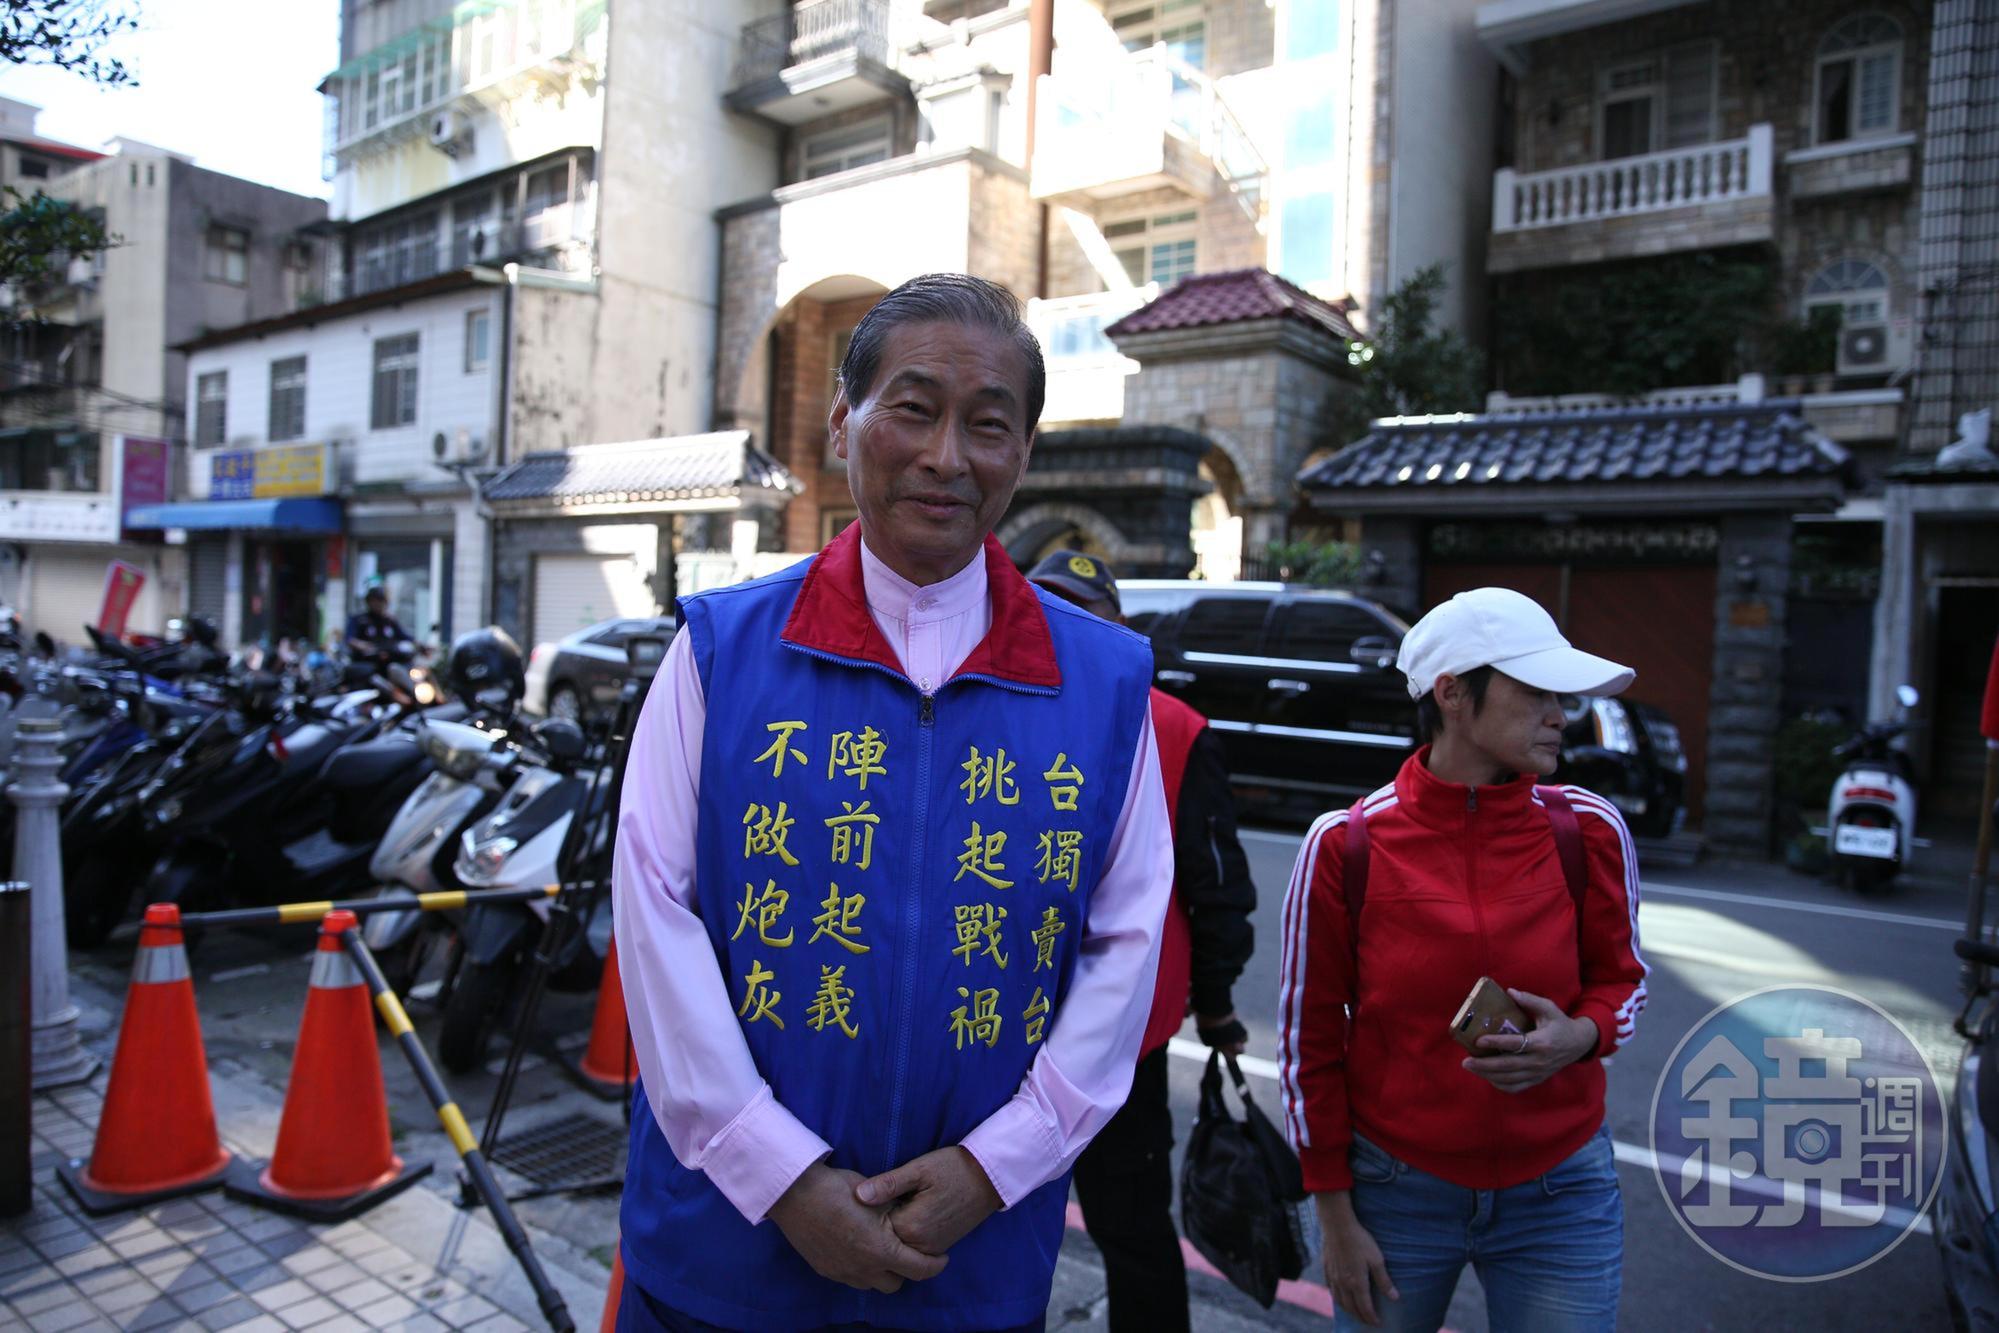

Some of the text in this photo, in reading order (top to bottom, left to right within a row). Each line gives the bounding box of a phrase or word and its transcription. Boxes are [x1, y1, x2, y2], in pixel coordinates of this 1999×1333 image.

[731, 720, 808, 1031] 不做炮灰
[806, 725, 888, 1040] 陣前起義
[948, 746, 1020, 1050] 挑起戰禍
[1022, 752, 1084, 1045] 台獨賣台
